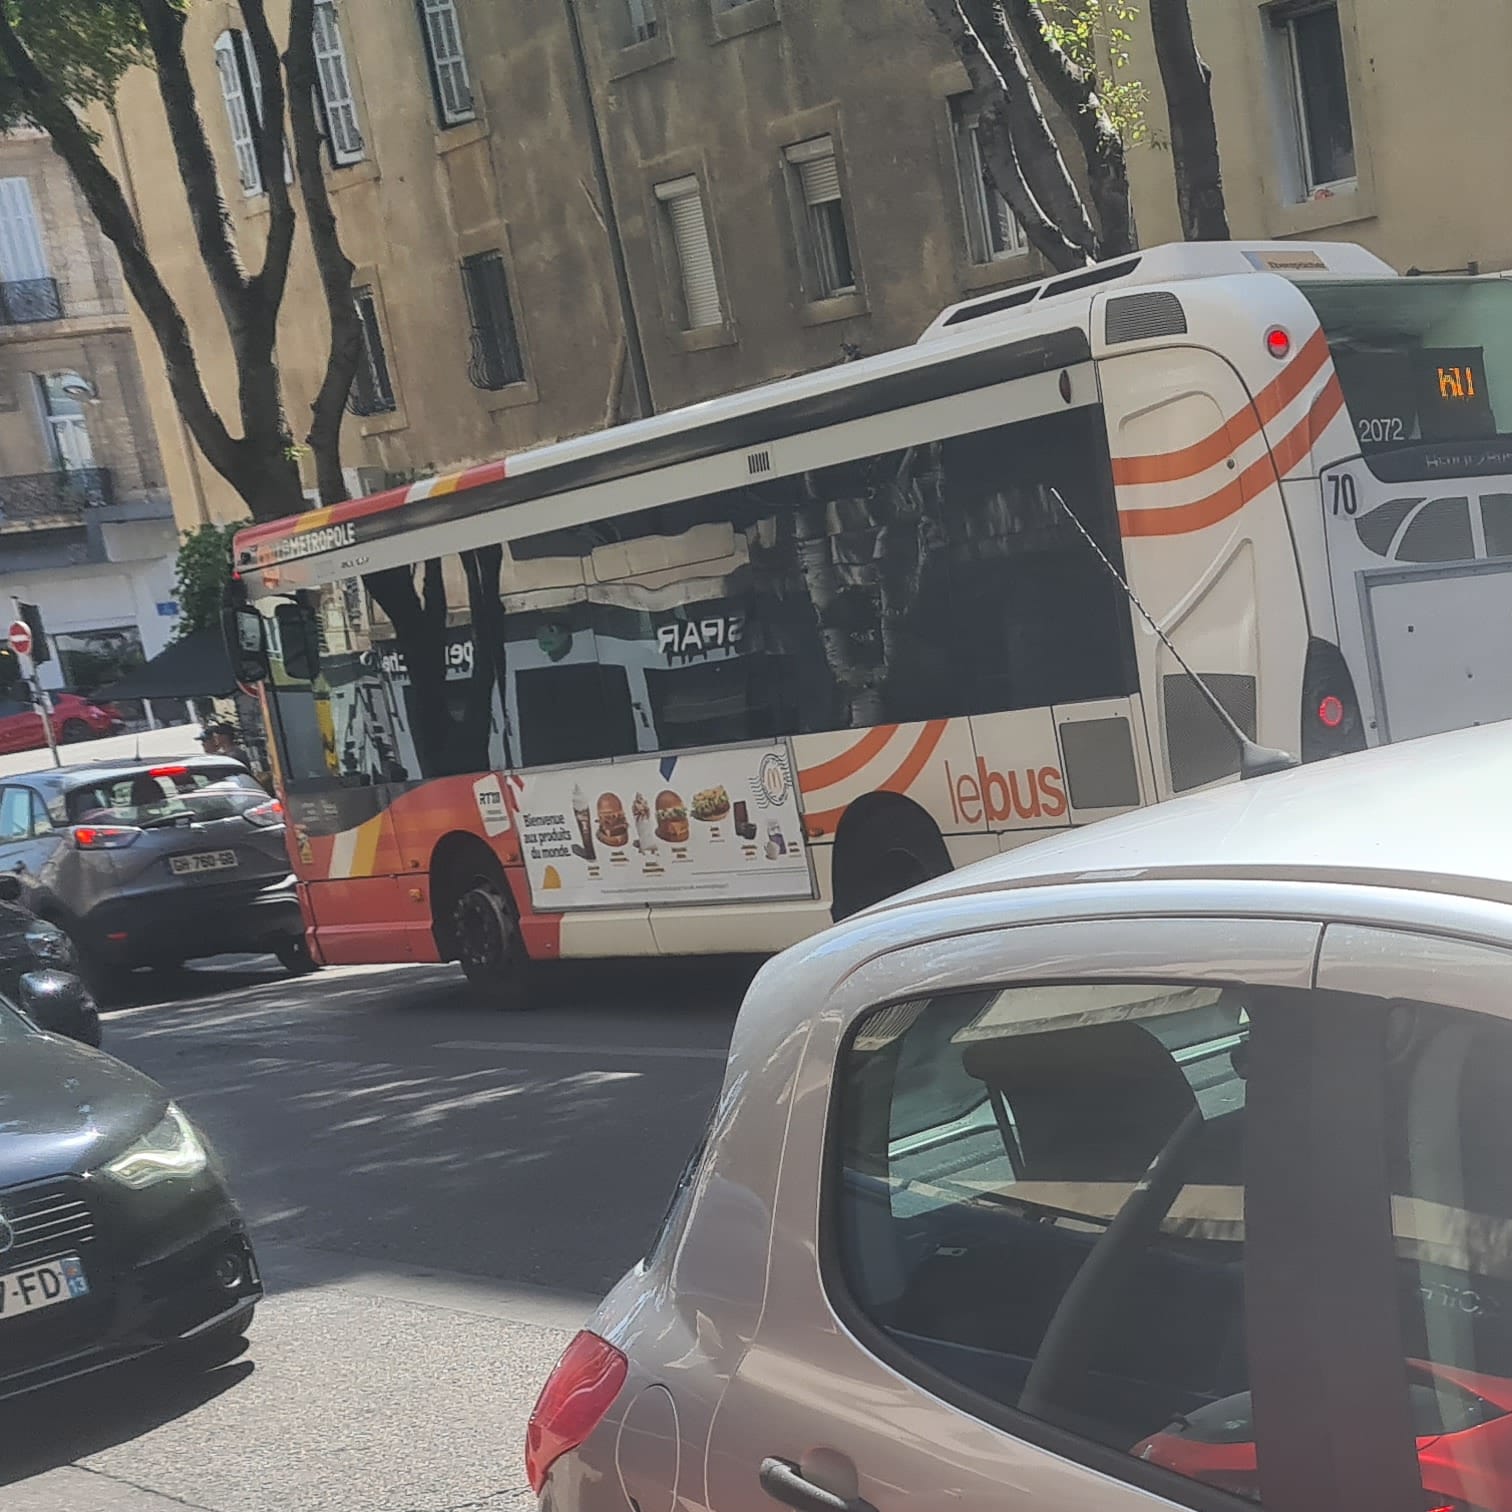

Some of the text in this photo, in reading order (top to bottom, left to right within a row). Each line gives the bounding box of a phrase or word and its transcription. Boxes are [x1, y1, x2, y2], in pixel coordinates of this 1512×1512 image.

[1359, 418, 1405, 442] 2072
[1328, 474, 1357, 516] 70
[523, 813, 565, 827] Bienvenue
[523, 827, 572, 846] aux produits
[530, 846, 541, 859] du
[69, 1276, 87, 1294] 13
